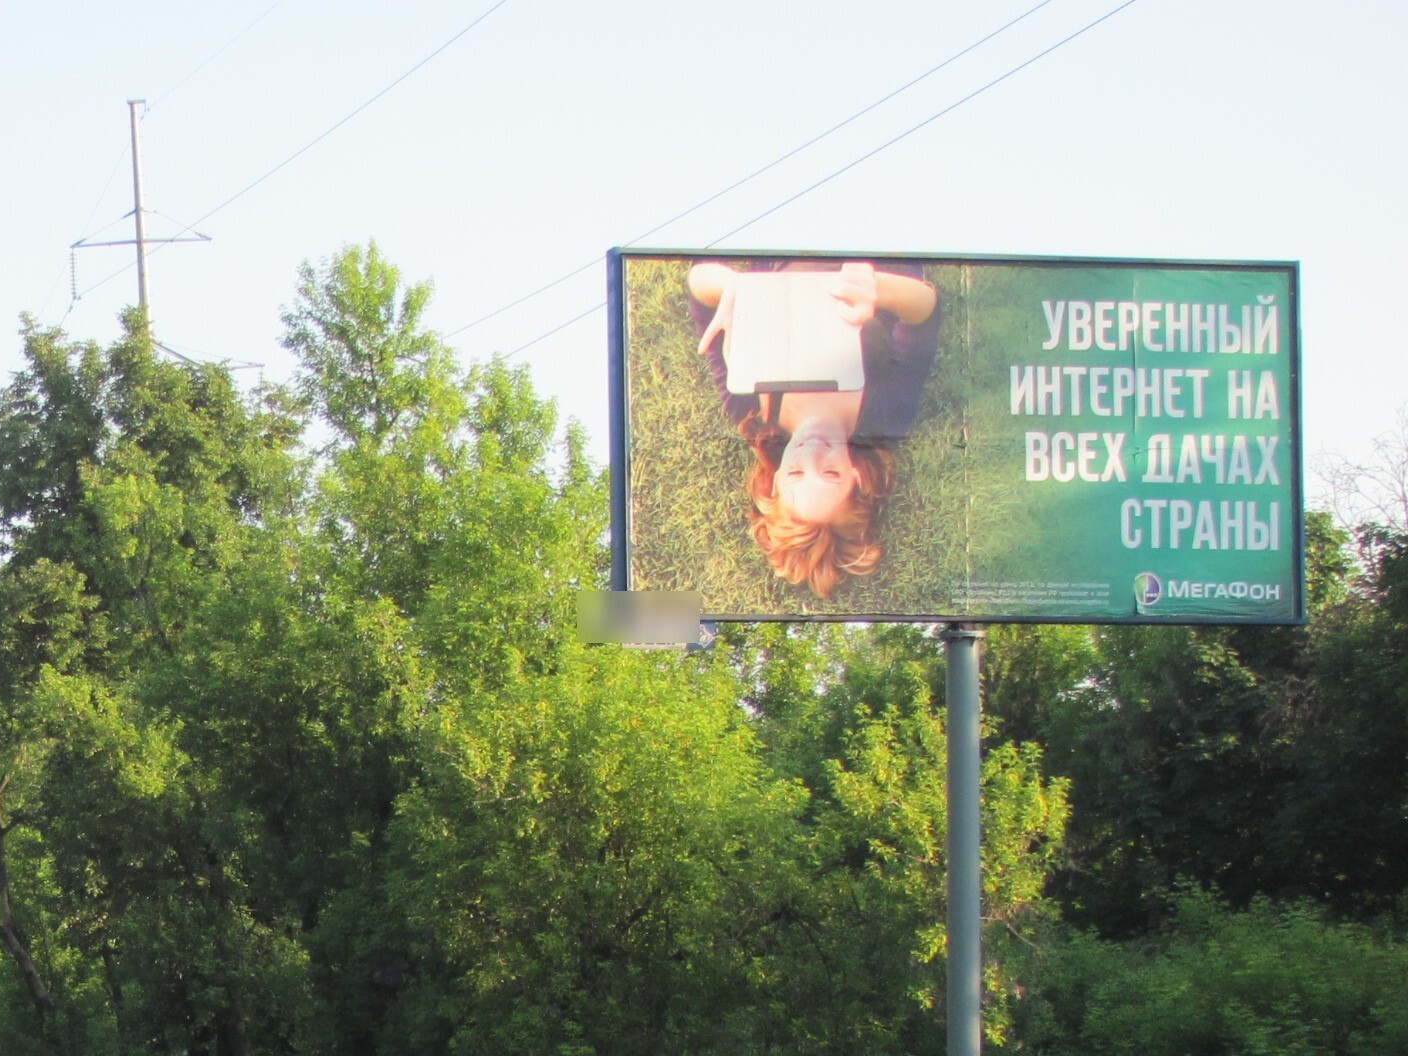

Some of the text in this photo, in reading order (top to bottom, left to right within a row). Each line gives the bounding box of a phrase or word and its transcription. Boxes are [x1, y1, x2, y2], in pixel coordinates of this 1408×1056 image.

[1041, 294, 1279, 355] УВЕРЕННЫЙ
[1009, 365, 1280, 420] ИНТЕРНЕТ НА
[1024, 431, 1281, 485] ВСЕХ ДАЧАХ
[1120, 498, 1280, 551] СТРАНЫ
